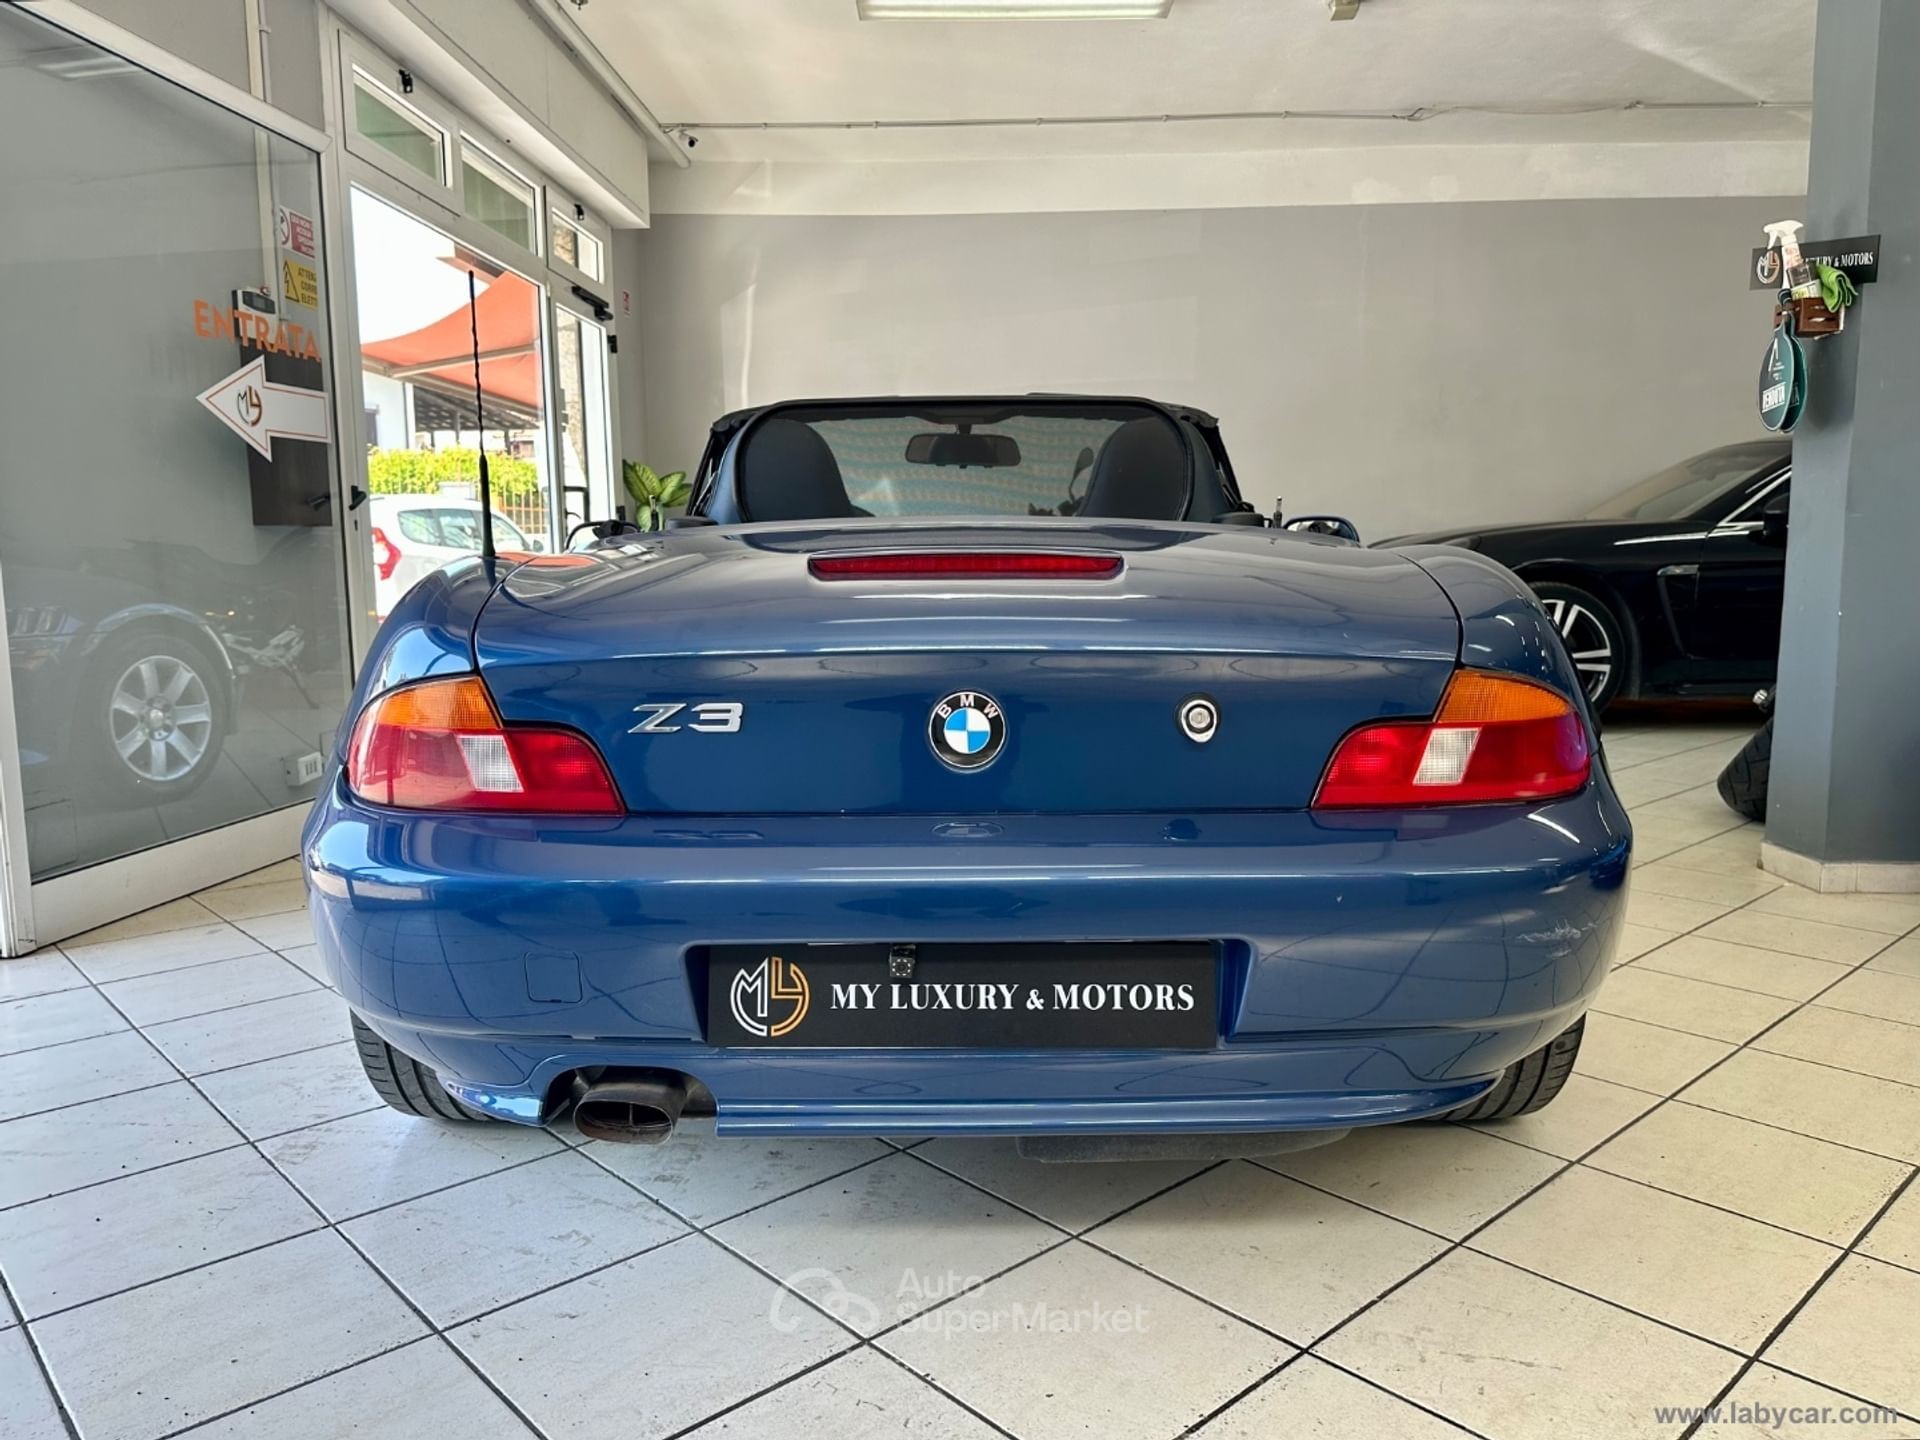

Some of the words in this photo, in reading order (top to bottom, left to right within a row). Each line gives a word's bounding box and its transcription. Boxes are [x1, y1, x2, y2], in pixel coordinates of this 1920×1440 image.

[1834, 257, 1840, 267] &
[1841, 252, 1874, 267] MOTORS
[193, 297, 321, 362] ENTRATA
[627, 703, 743, 733] Z3
[937, 694, 999, 719] BMW
[831, 983, 882, 1010] MY
[890, 983, 1020, 1010] LUXURY
[1025, 989, 1045, 1011] &
[1052, 983, 1195, 1010] MOTORS
